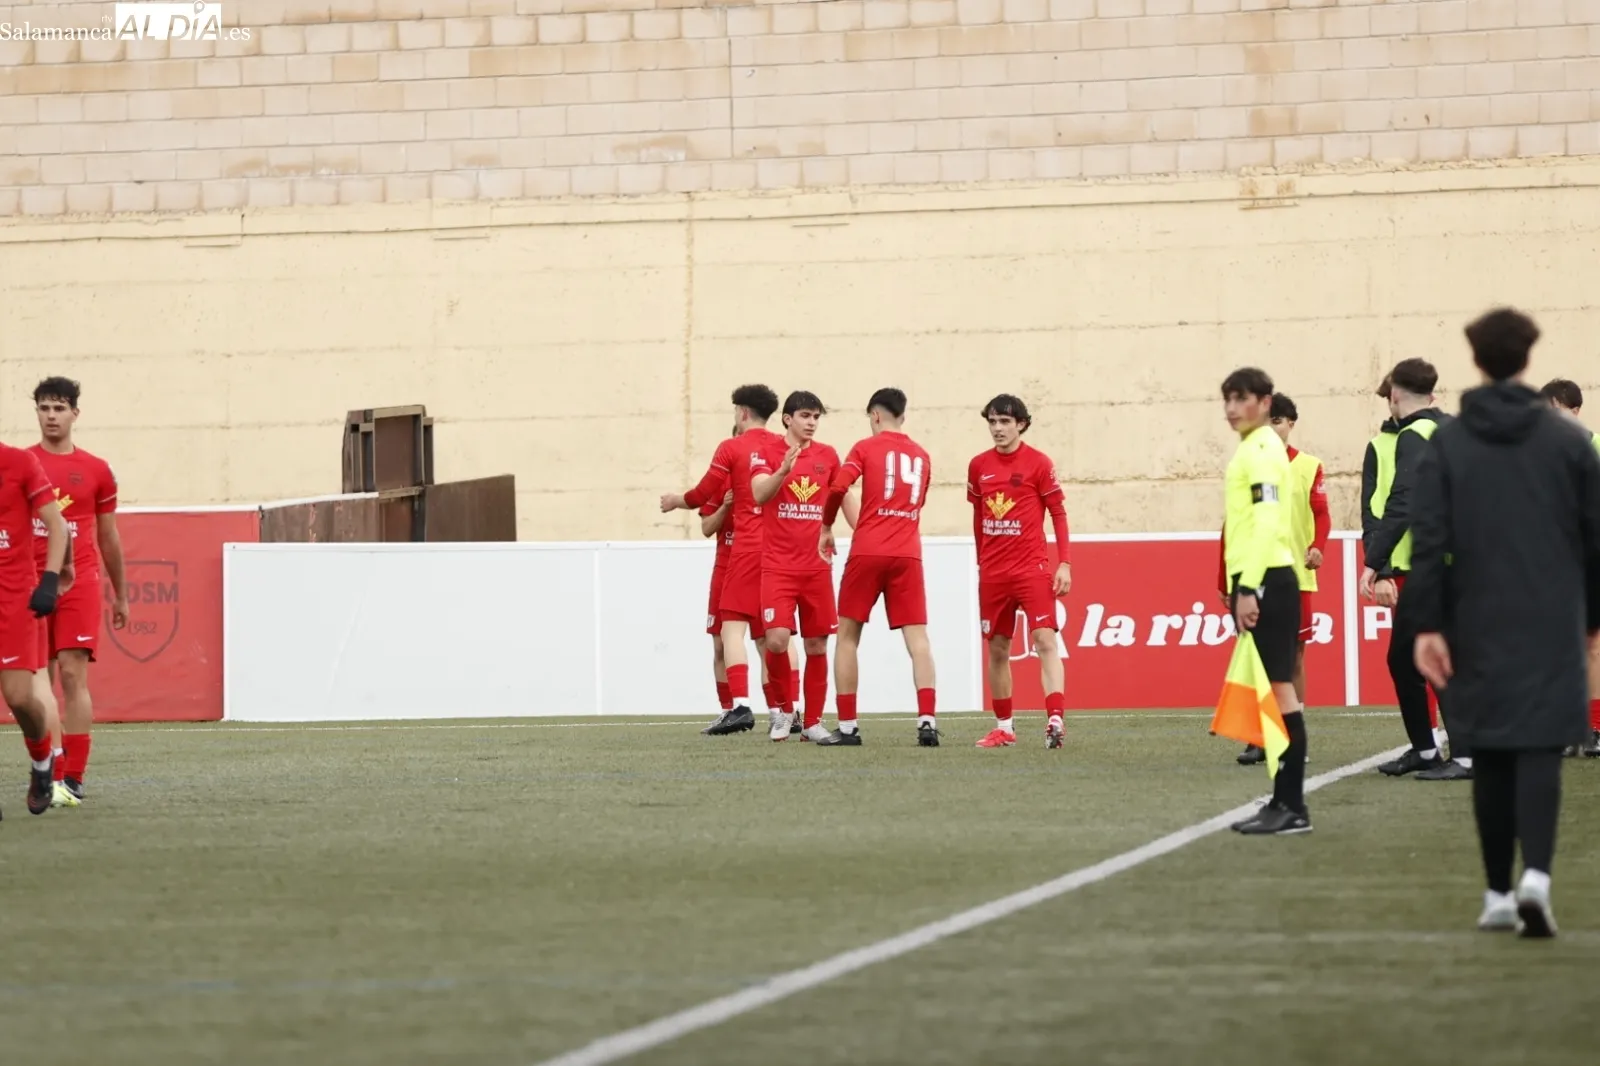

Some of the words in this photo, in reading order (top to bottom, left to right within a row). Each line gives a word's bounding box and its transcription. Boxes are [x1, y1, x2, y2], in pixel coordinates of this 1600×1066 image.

[884, 450, 923, 505] 14
[778, 503, 798, 512] CAJA
[1077, 603, 1136, 647] la
[1146, 601, 1334, 646] riva
